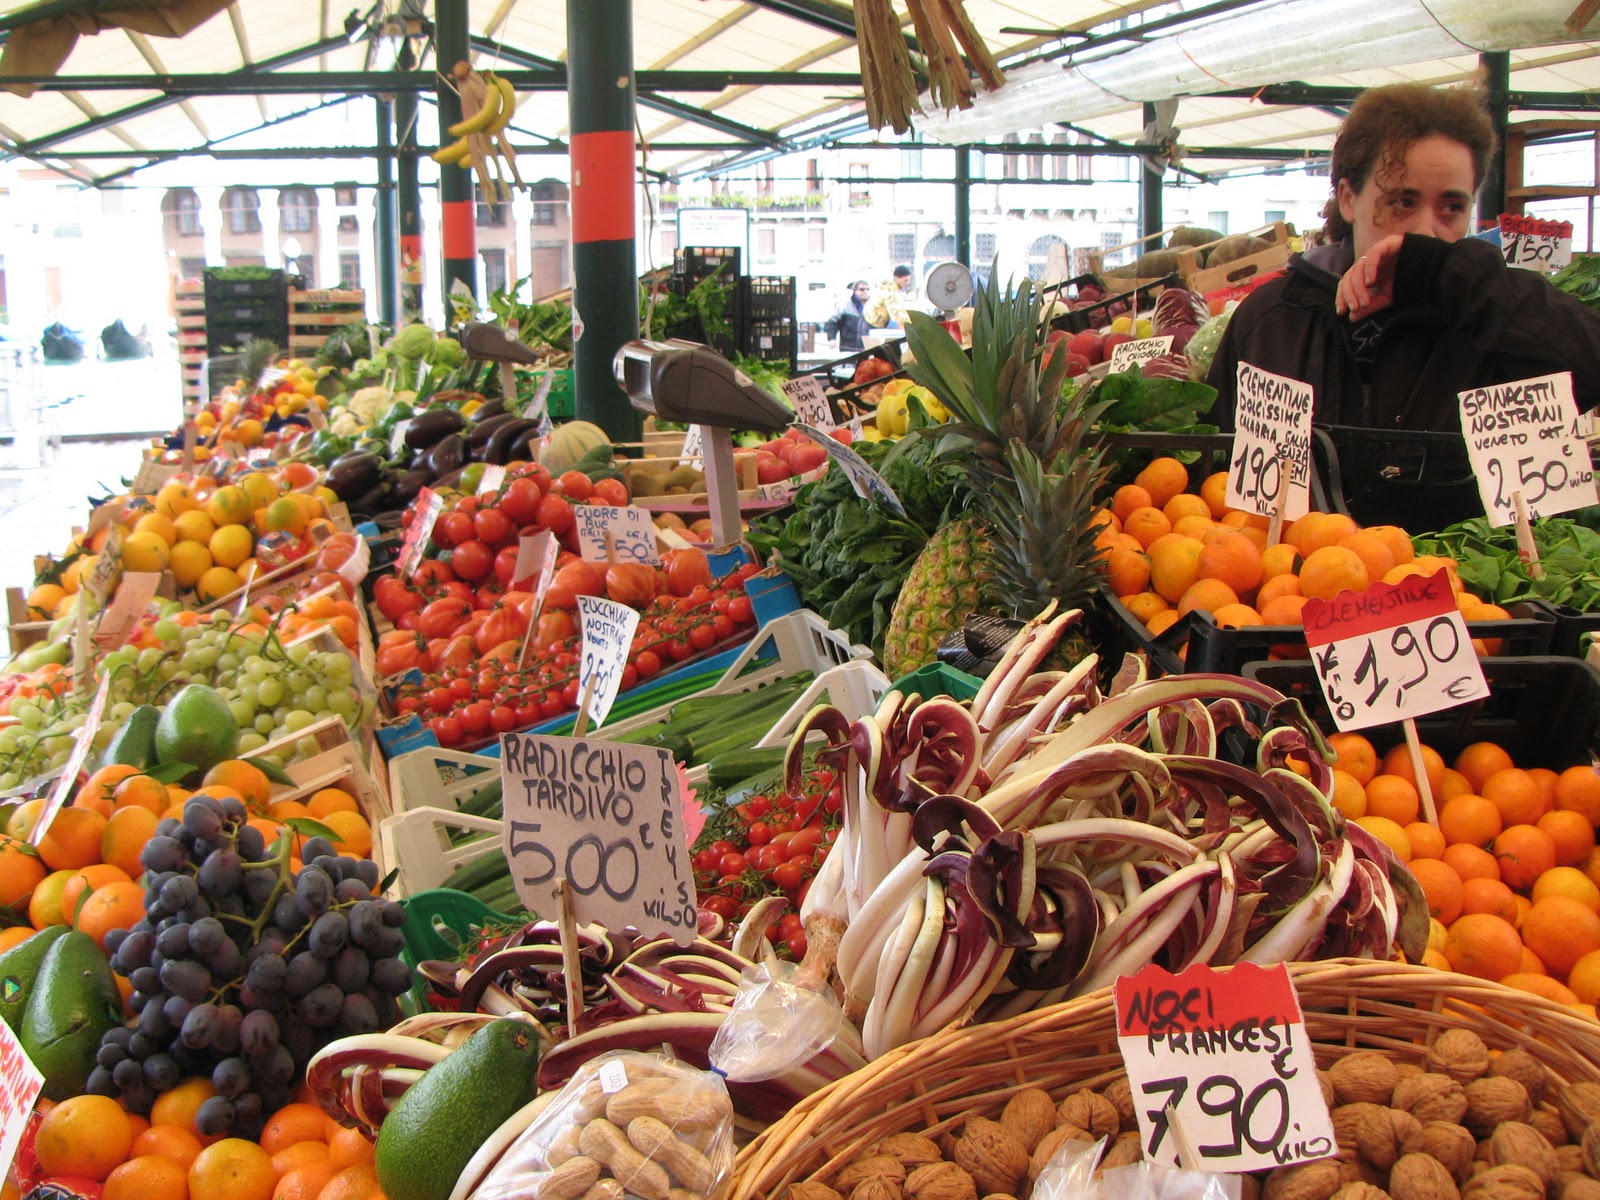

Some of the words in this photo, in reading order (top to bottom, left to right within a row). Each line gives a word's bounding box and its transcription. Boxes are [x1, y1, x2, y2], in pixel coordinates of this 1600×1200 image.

[1116, 340, 1165, 357] RADICCHIO
[1127, 348, 1166, 361] CHIOGGIA
[782, 381, 803, 396] MELE
[1239, 366, 1310, 414] CLEMENTINE
[1463, 380, 1557, 417] SPINACETTI
[1239, 391, 1302, 428] DOLCISSIME
[1471, 404, 1562, 434] NOSTRANI
[1239, 413, 1277, 445] CALABRIA
[1275, 442, 1309, 467] SENZA
[576, 506, 619, 520] CUORE
[627, 510, 640, 522] DI
[585, 520, 609, 530] BUE
[578, 597, 631, 629] ZUCCHINE
[1315, 582, 1440, 630] CLEMENTINE
[1353, 616, 1460, 709] 1,90
[1441, 675, 1482, 700] €
[504, 733, 646, 793] RADICCHIO
[522, 778, 634, 826] TARDIVO
[1124, 986, 1214, 1031] NOCI
[1147, 1015, 1292, 1057] FRANCESI
[1270, 1046, 1298, 1080] €
